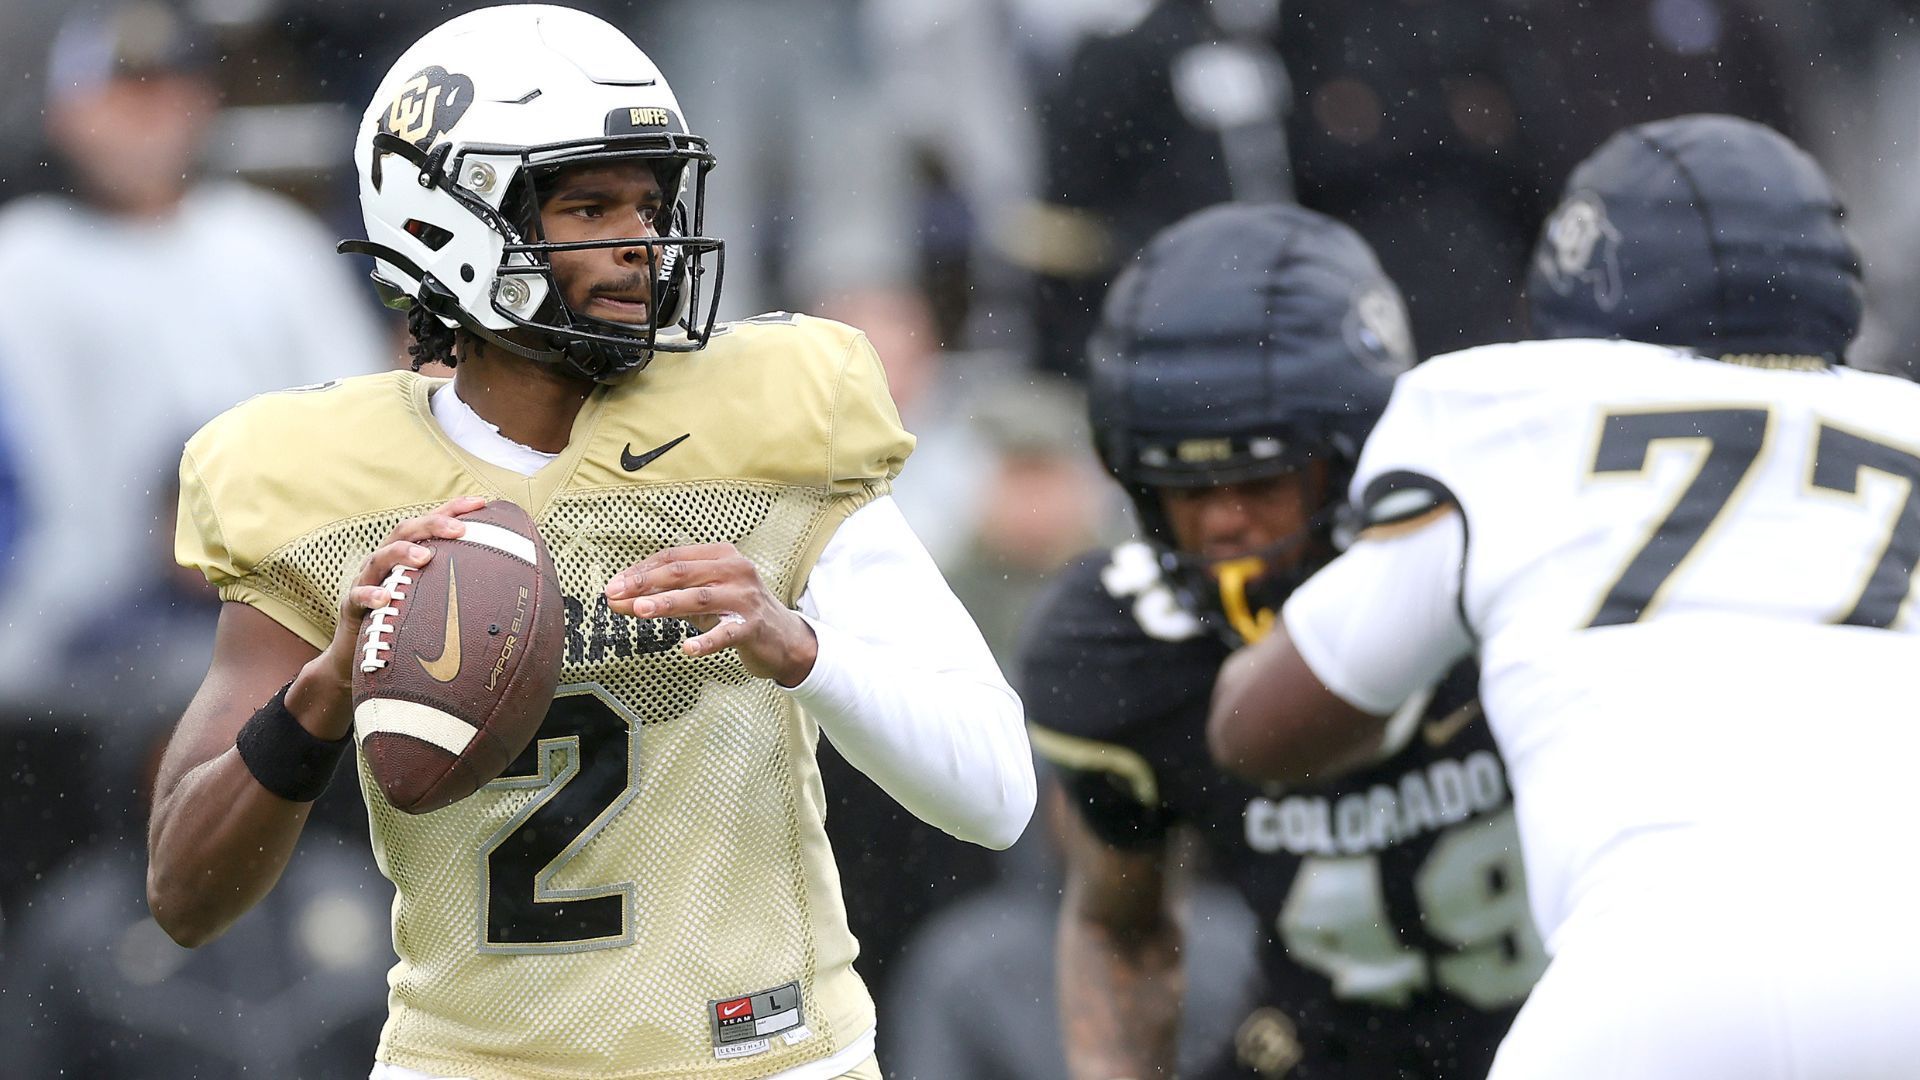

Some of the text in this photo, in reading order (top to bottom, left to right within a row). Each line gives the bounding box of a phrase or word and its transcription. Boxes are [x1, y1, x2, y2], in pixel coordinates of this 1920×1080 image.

[629, 107, 669, 127] BUFFS
[1576, 400, 1920, 632] 77
[484, 585, 529, 692] VAPOR ELITE
[477, 682, 642, 955] 2
[1243, 749, 1504, 856] COLORADO
[1276, 806, 1554, 1012] 49
[723, 1015, 751, 1025] TEAM
[769, 995, 781, 1011] L
